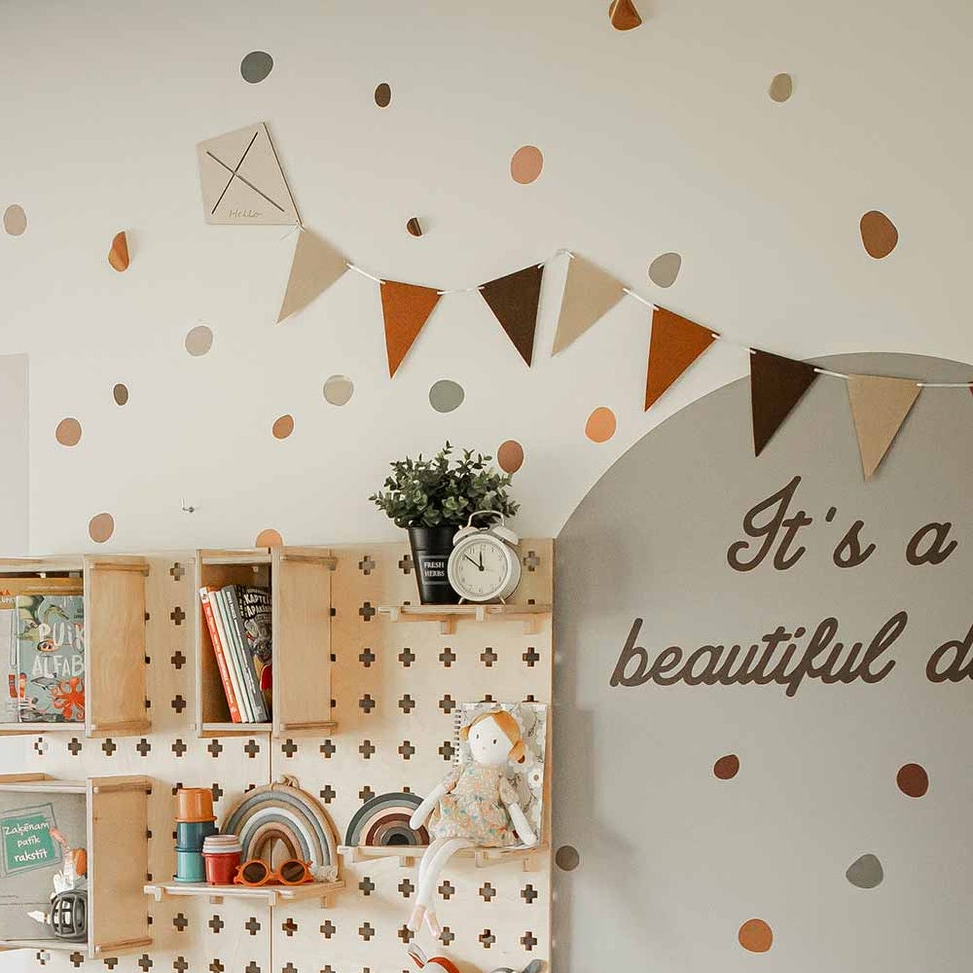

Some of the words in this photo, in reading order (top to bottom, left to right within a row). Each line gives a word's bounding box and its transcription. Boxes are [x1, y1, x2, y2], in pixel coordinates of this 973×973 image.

[423, 561, 444, 569] FRESH
[727, 475, 876, 572] It's
[905, 521, 958, 566] a
[609, 610, 907, 697] beautiful
[925, 624, 973, 684] d
